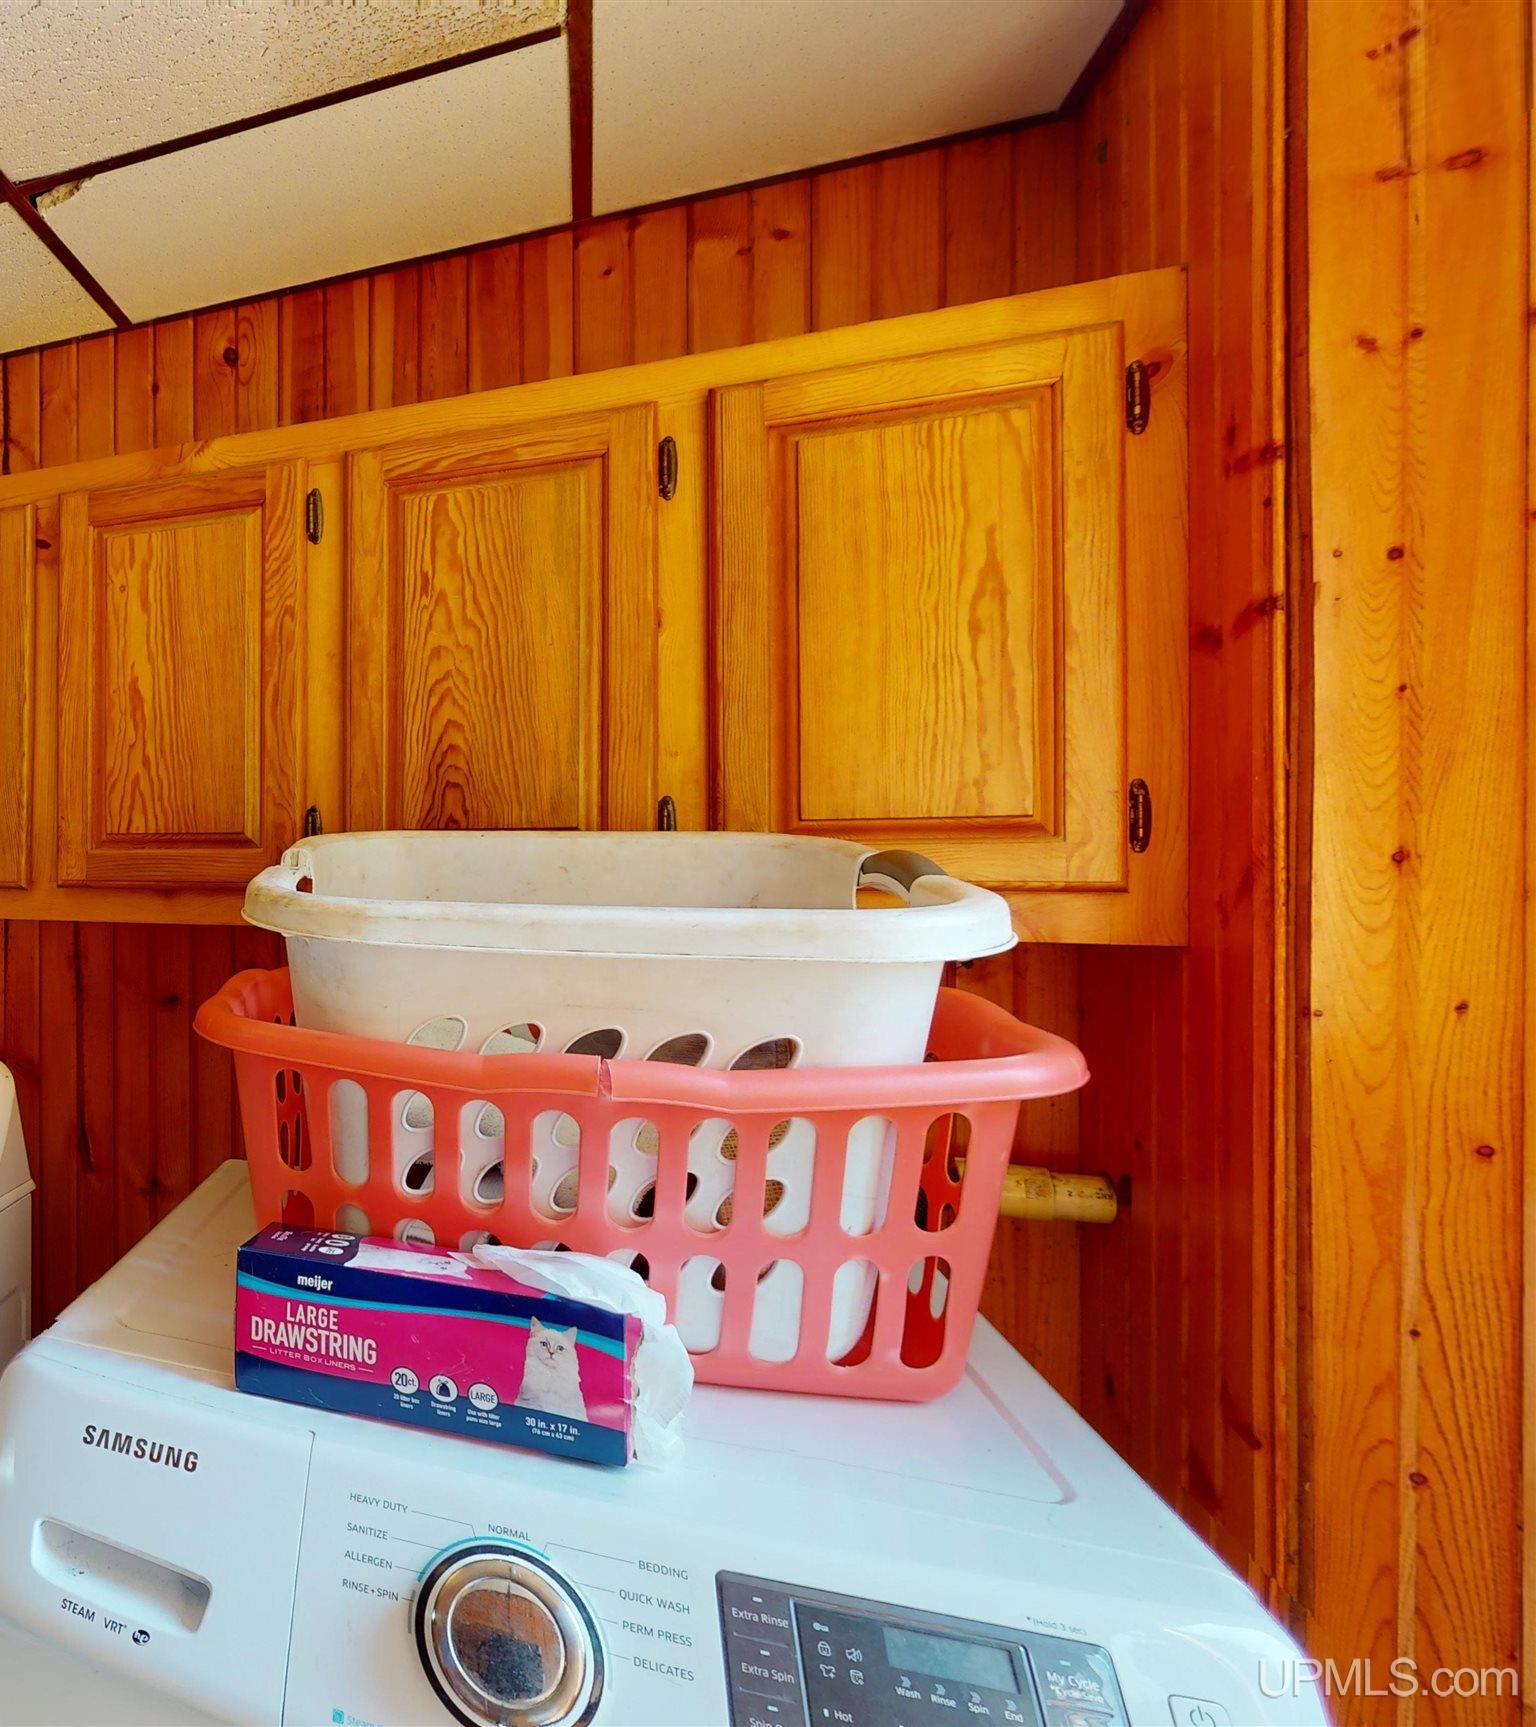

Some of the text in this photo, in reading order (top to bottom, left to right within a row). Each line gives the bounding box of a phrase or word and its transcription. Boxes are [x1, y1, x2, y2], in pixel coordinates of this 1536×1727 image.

[297, 1275, 333, 1291] meijer
[286, 1301, 339, 1330] LARGE
[251, 1315, 377, 1365] DRAWSTRING
[269, 1347, 356, 1371] LITTER BOX LINERS
[430, 1401, 457, 1413] Drawstring
[470, 1390, 496, 1404] LARGE
[489, 1419, 502, 1428] large
[525, 1416, 581, 1436] 30 in. x 17 in.
[82, 1424, 200, 1473] SAMSUNG
[349, 1492, 408, 1514] HEAVY DUTY
[347, 1521, 389, 1540] SANITIZE
[487, 1523, 531, 1542] NORMAL
[344, 1550, 393, 1570] ALLERGEN
[638, 1559, 689, 1581] BEDDING
[61, 1598, 96, 1623] STEAM
[618, 1588, 691, 1615] QUICK WASH
[731, 1607, 789, 1629] Extra Rinse
[622, 1619, 693, 1648] PERM PRESS
[633, 1656, 695, 1682] DELICATES
[741, 1662, 795, 1684] Extra Spin
[1046, 1671, 1100, 1692] My Cycle
[895, 1686, 921, 1700] Wash
[930, 1694, 957, 1708] Rinse
[834, 1710, 854, 1723] Hot
[967, 1702, 990, 1715] Spin
[1004, 1711, 1024, 1723] End
